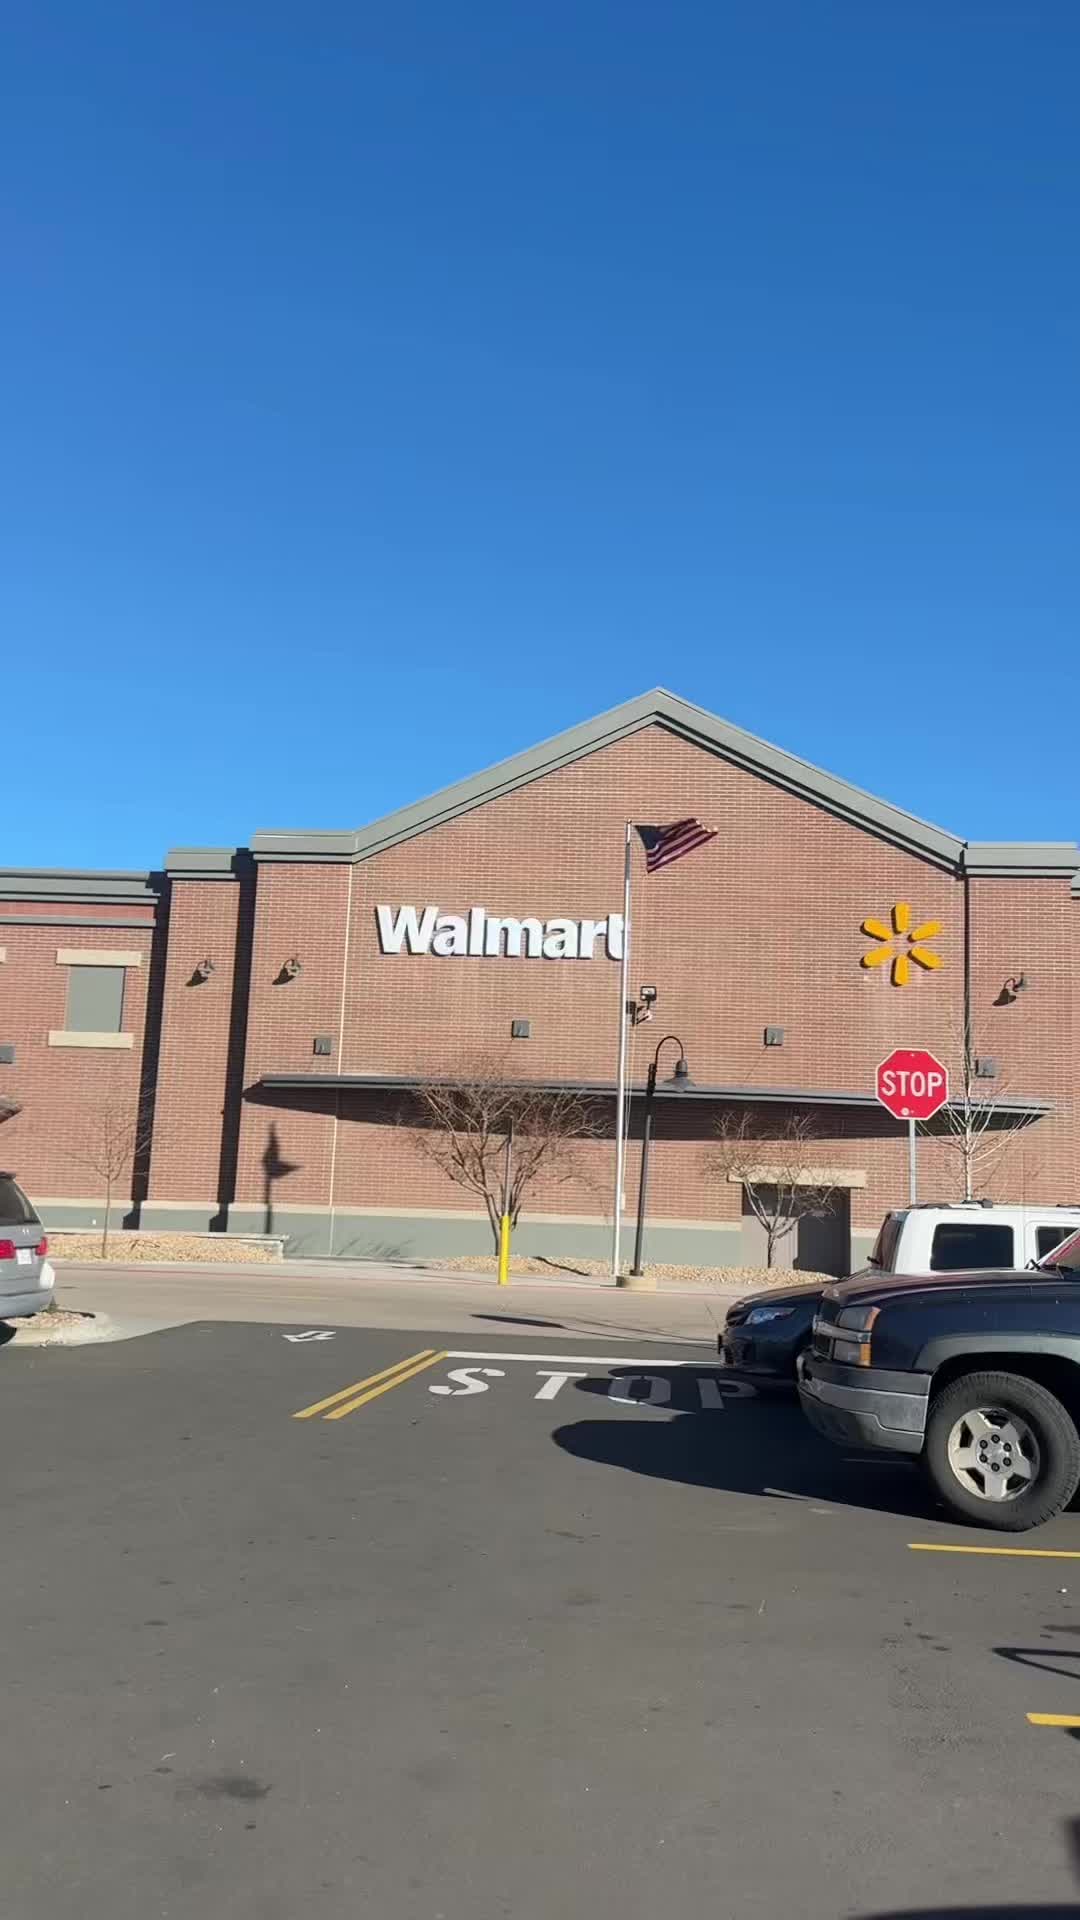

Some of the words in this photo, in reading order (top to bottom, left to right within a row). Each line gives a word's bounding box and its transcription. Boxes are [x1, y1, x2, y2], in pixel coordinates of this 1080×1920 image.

[375, 904, 627, 960] Walmart
[881, 1070, 943, 1098] STOP
[428, 1367, 757, 1409] STOP
